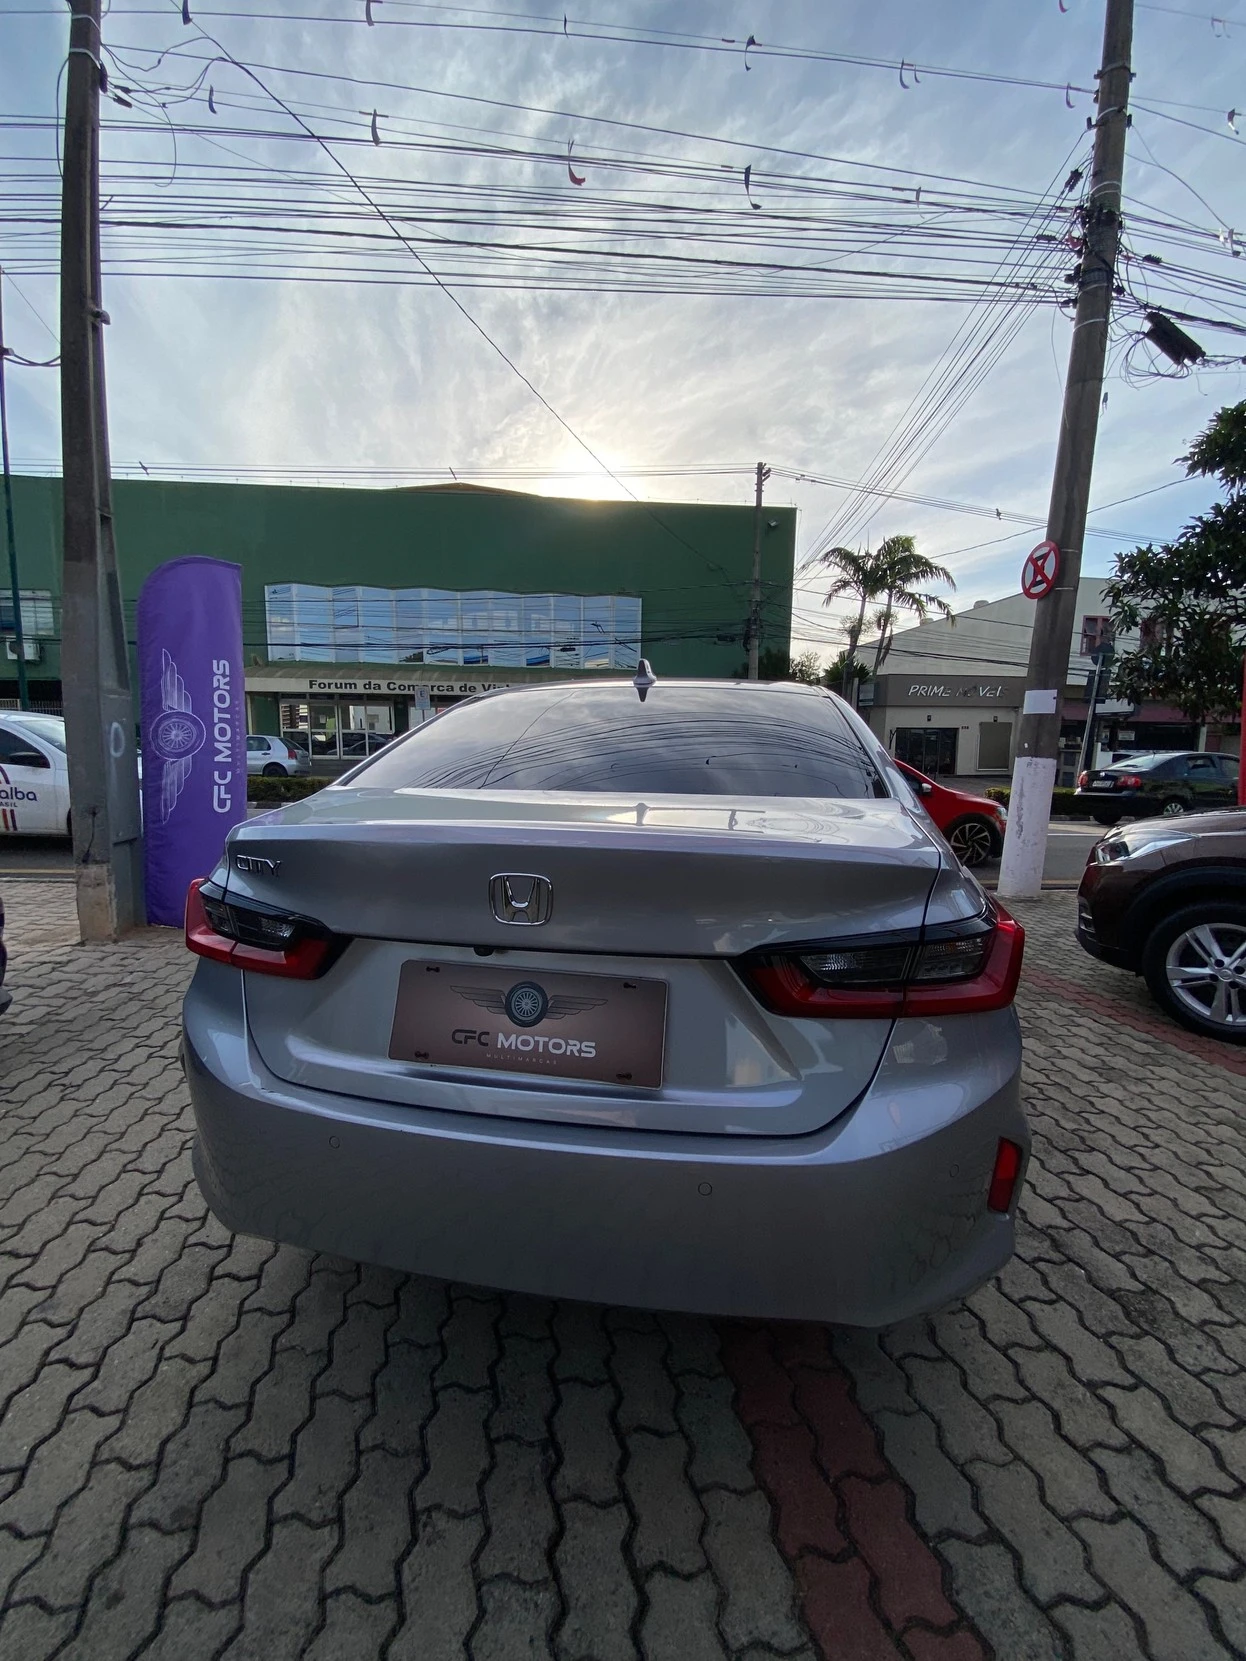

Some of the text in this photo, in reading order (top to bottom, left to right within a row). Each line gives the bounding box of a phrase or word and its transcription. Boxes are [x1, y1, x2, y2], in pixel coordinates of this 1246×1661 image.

[308, 679, 358, 690] Forum
[362, 680, 382, 691] da
[386, 681, 455, 692] Comrca
[459, 683, 477, 693] de
[908, 684, 1009, 698] PRIME MVEI
[212, 659, 232, 813] CFC MOTORS
[236, 854, 281, 876] CITY
[451, 1028, 597, 1059] CFC MOTORS
[486, 1053, 558, 1065] MULTIMARCAS
